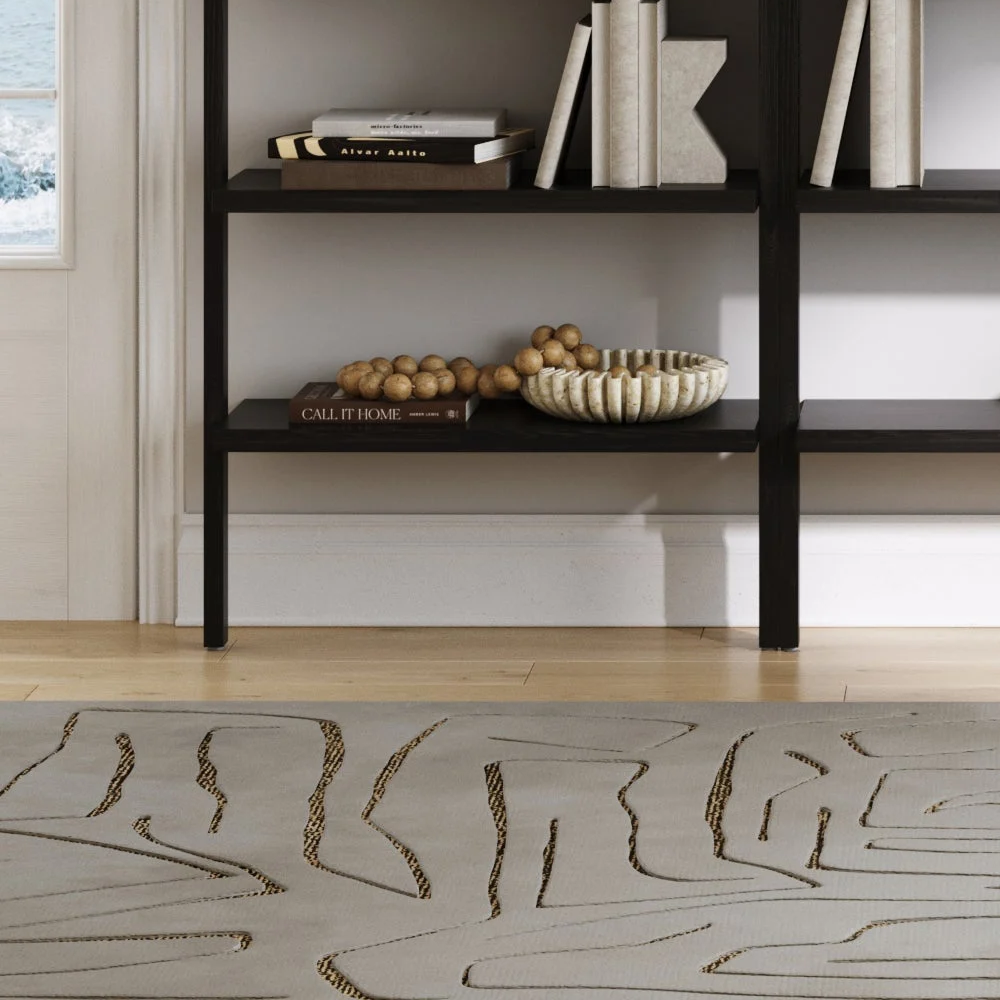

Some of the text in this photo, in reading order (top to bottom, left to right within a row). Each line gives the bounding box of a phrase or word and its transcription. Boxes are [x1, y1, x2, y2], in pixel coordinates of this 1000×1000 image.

[388, 149, 427, 157] Aalto
[301, 408, 337, 421] CALL
[341, 408, 355, 421] IT
[358, 408, 402, 421] HOME
